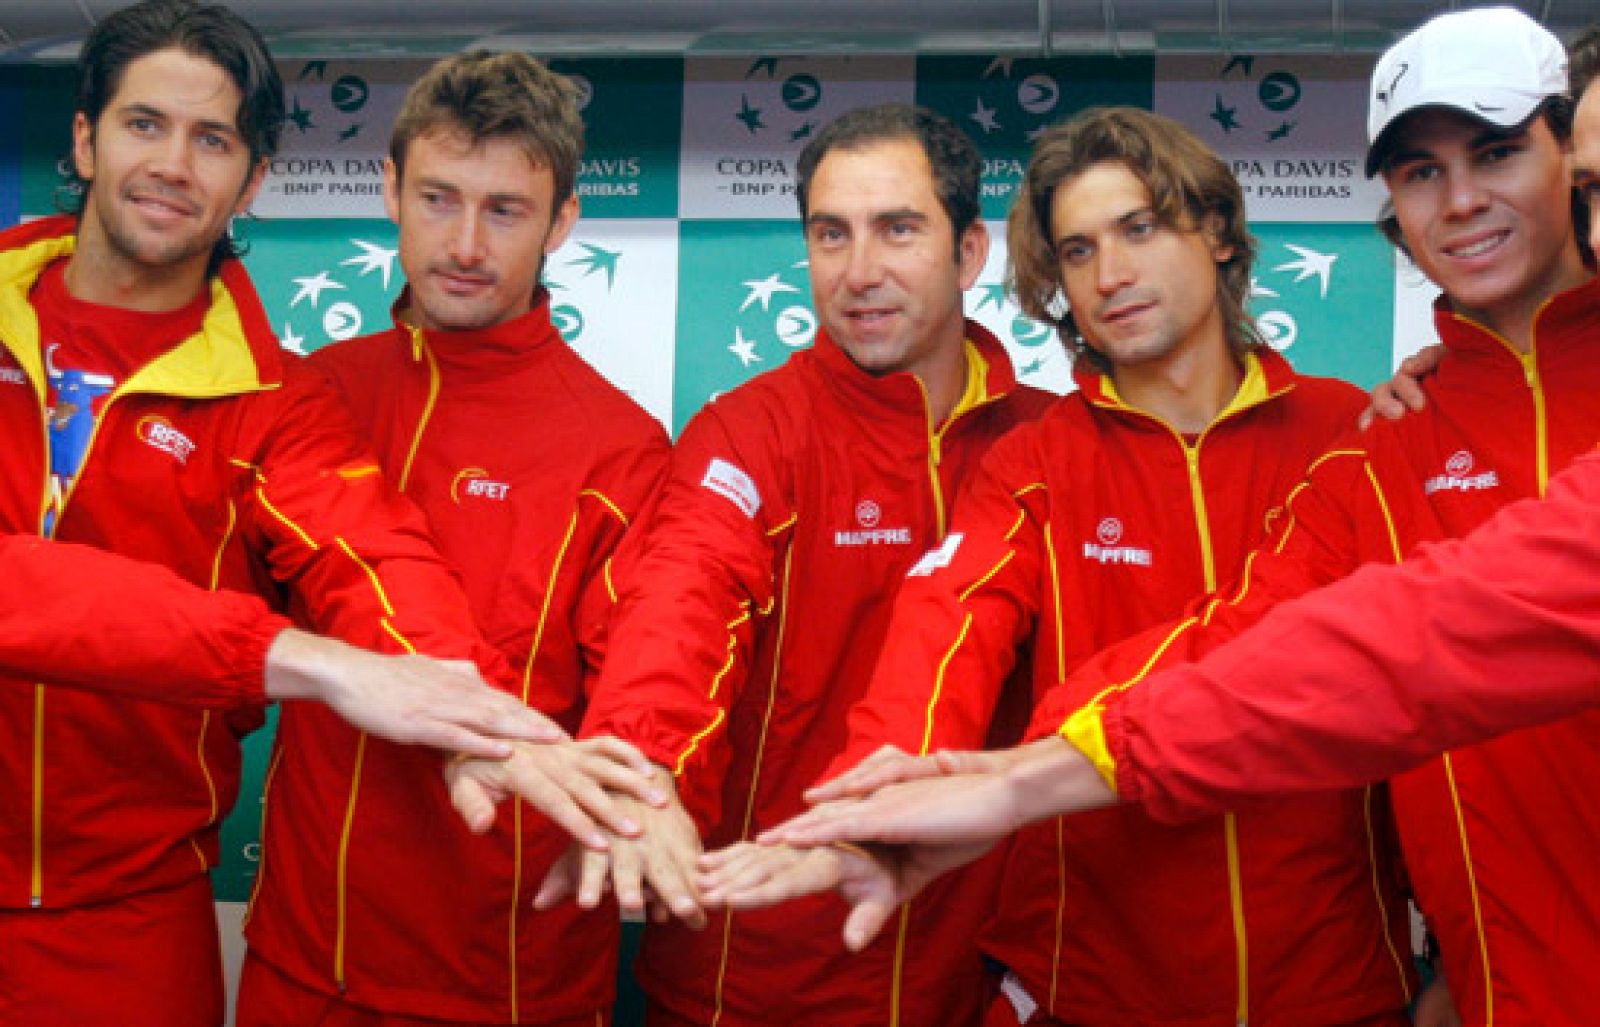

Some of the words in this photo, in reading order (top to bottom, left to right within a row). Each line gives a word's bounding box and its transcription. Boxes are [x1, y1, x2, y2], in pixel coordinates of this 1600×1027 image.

[270, 159, 336, 175] COPA
[718, 159, 788, 176] COPA
[1232, 159, 1266, 177] PA
[1273, 159, 1354, 177] DAVIS
[284, 182, 324, 196] BNP
[578, 183, 639, 196] RIBAS
[732, 182, 775, 196] BNP
[980, 183, 1013, 196] NP
[467, 479, 511, 501] RFET
[834, 528, 911, 546] MAPFRE
